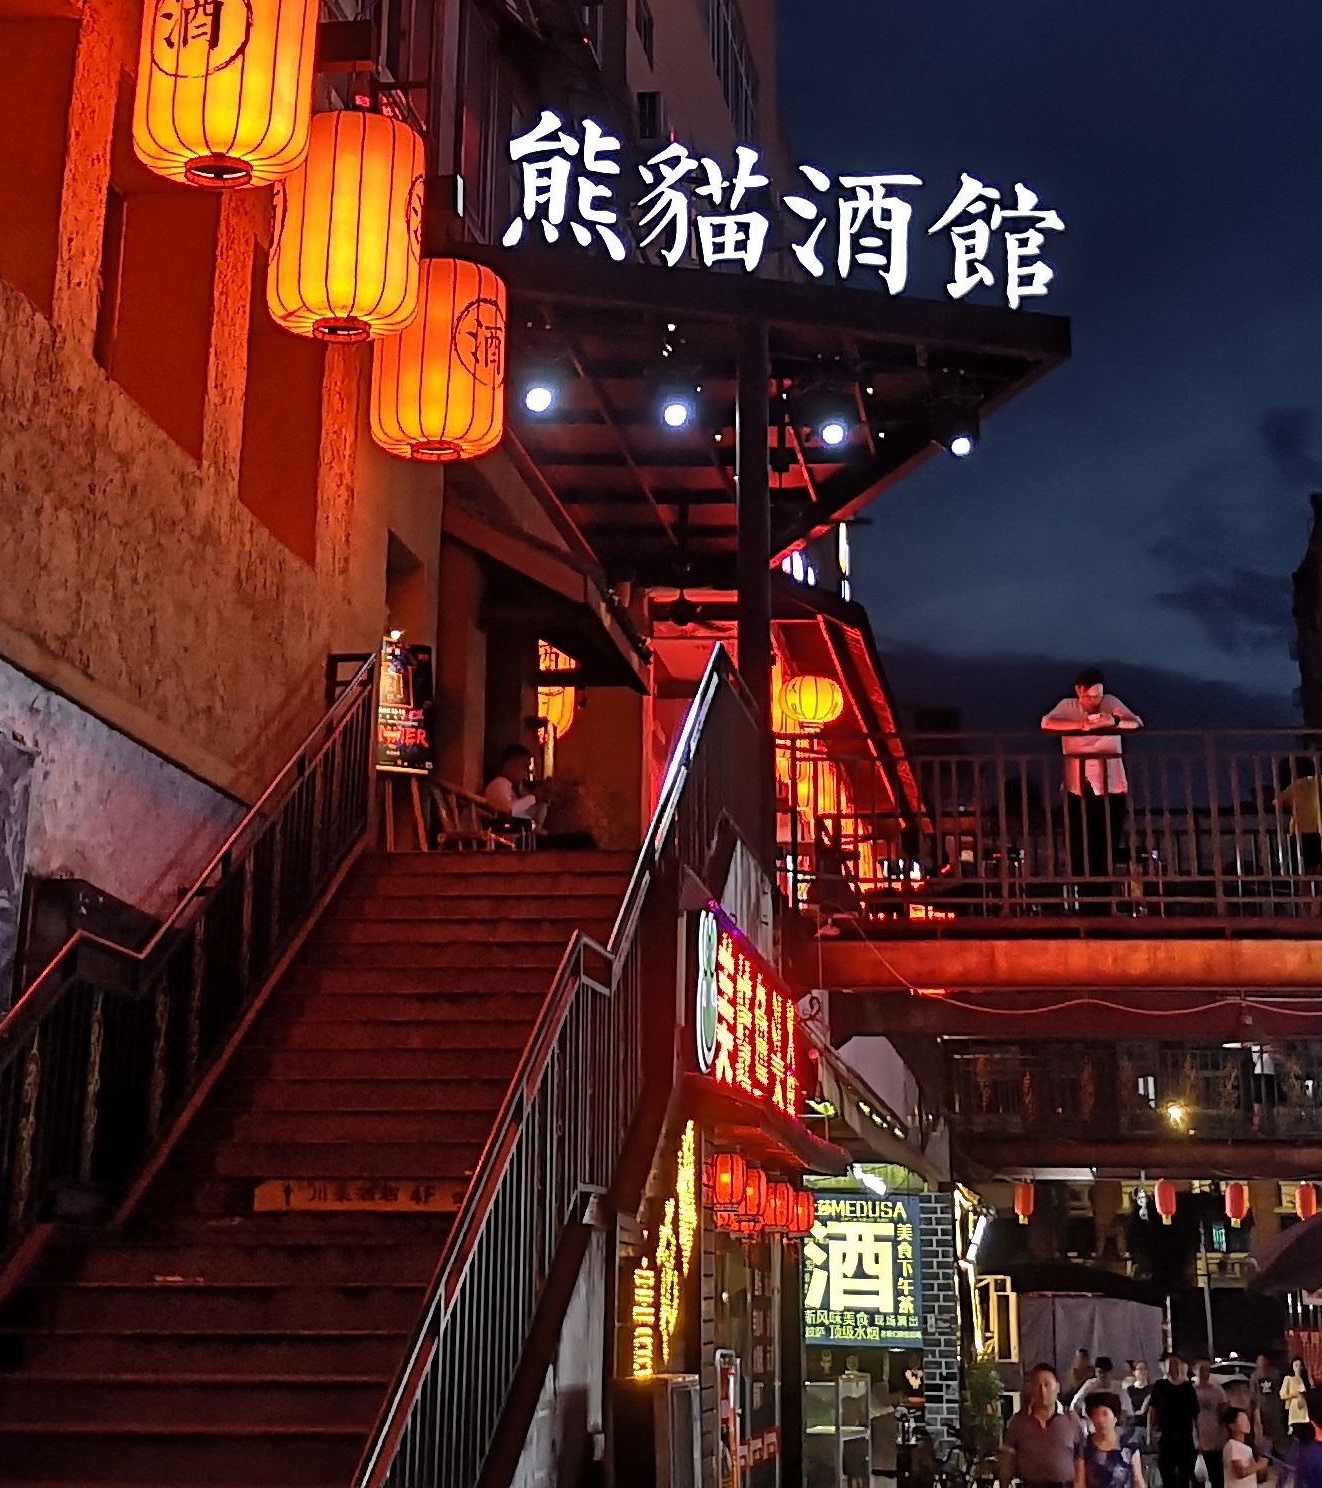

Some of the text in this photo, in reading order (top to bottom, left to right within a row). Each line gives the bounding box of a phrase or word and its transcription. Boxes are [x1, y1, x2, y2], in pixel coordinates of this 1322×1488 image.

[502, 110, 1067, 311] 熊貓酒館
[470, 320, 504, 377] 酒
[804, 1220, 895, 1313] 酒
[896, 1224, 916, 1314] 美食下午茶
